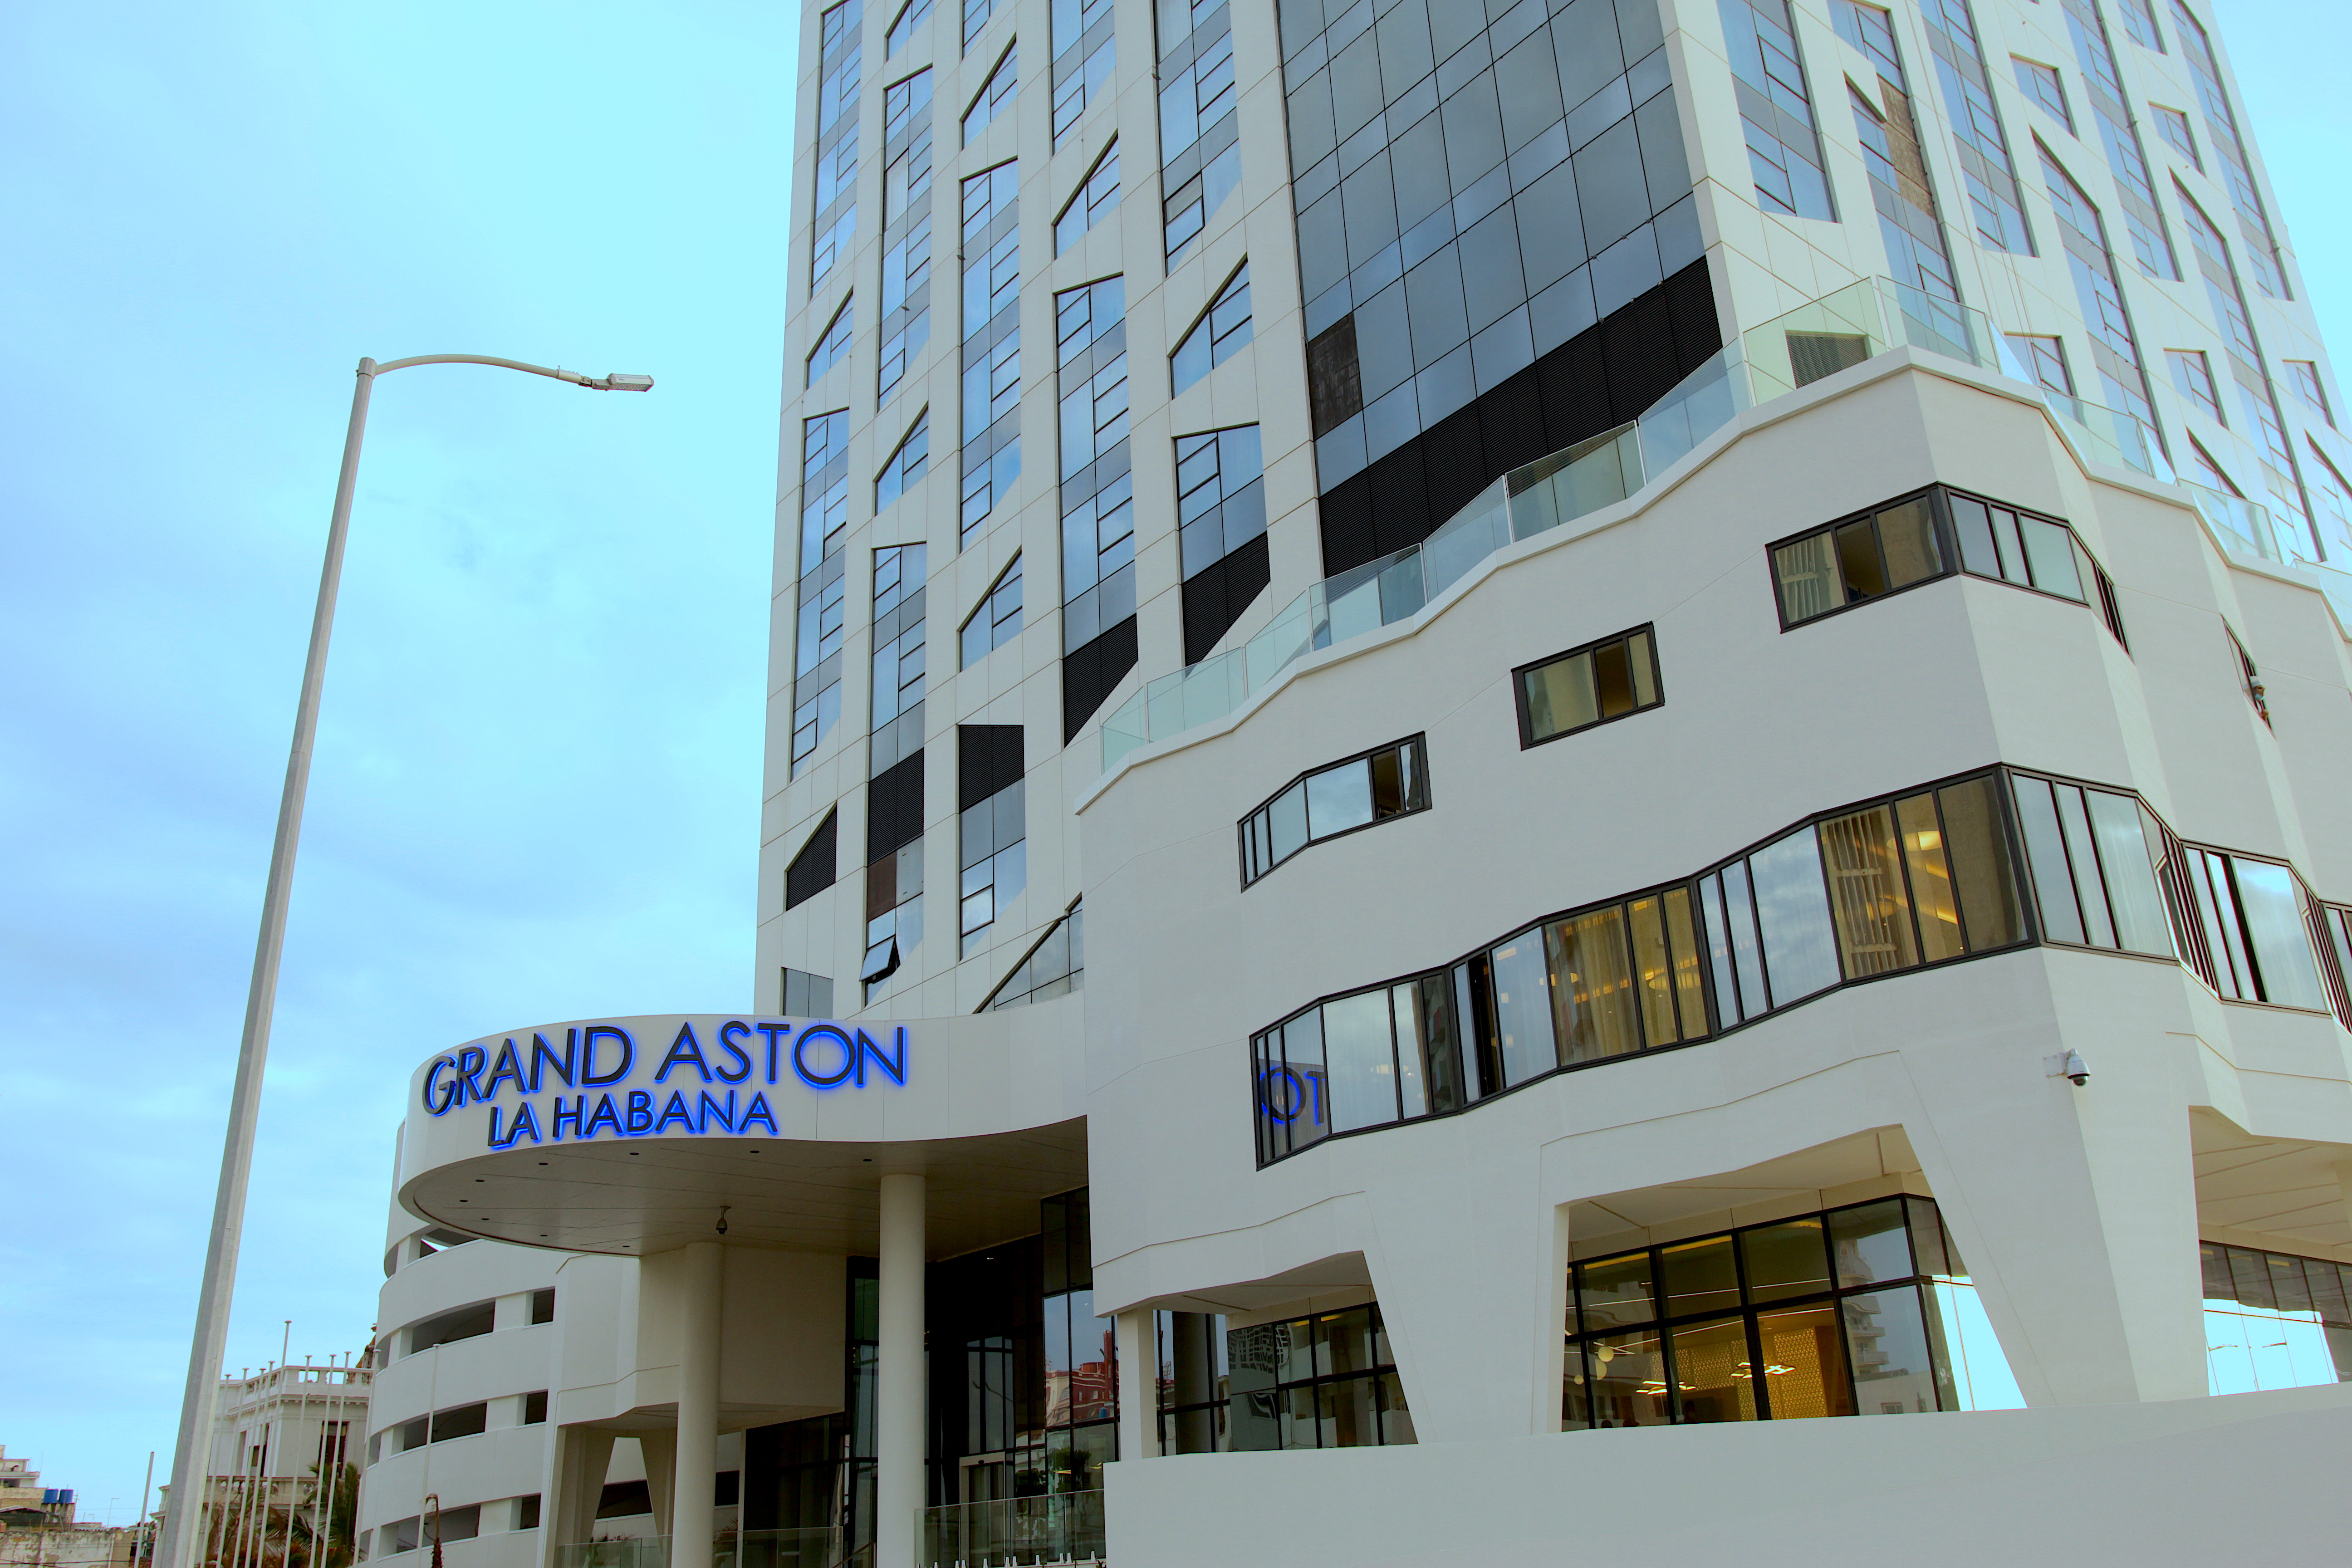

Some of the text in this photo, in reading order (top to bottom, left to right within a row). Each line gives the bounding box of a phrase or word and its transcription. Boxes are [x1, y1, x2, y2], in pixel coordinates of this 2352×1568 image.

[422, 1021, 904, 1115] GRAND ASTON
[487, 1090, 778, 1147] LA HABANA
